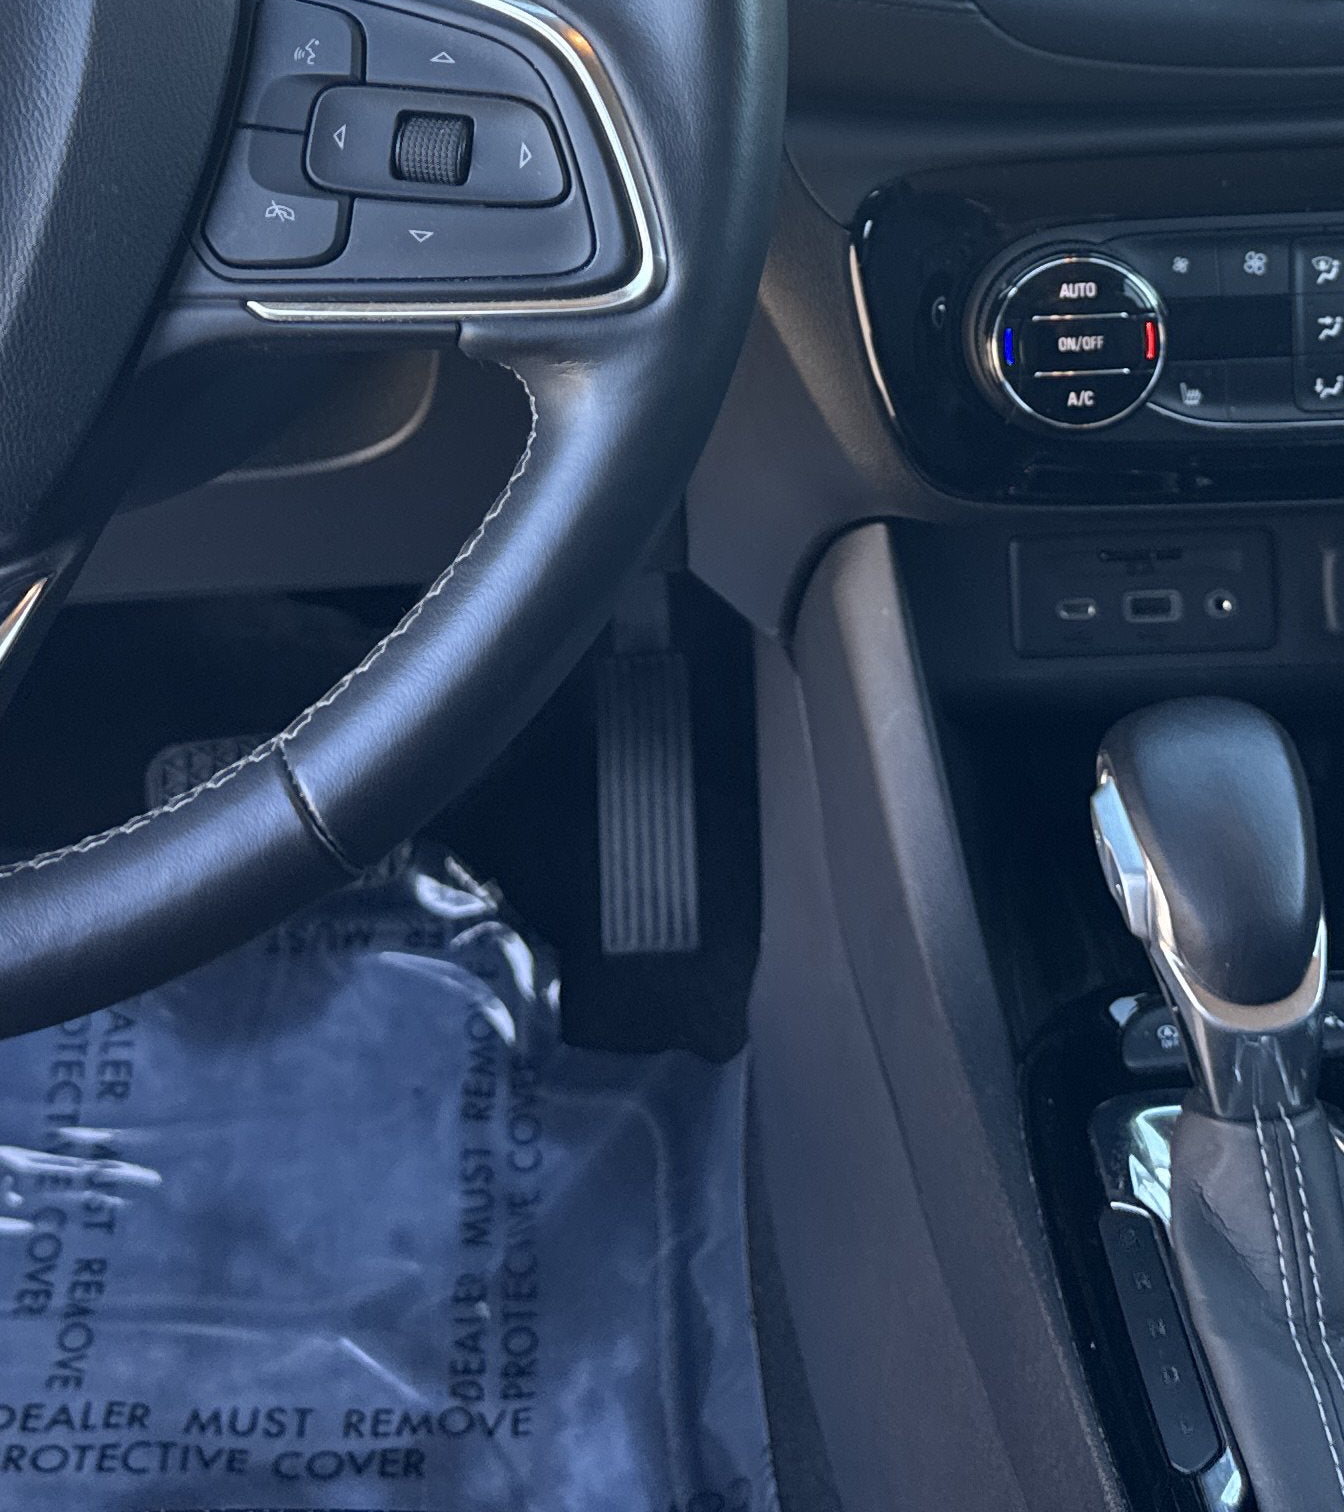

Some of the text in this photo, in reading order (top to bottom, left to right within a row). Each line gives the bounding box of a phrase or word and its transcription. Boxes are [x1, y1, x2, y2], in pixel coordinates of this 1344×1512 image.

[1059, 282, 1097, 299] AUTO
[1058, 336, 1104, 353] ON/OFF
[1067, 390, 1095, 407] A/C
[460, 1147, 494, 1247] MUST
[13, 1207, 67, 1317] COVER
[45, 1258, 107, 1389] REMOVE
[182, 1407, 315, 1441] MUST
[342, 1404, 534, 1441] REMOVE
[270, 1446, 426, 1482] COVER
